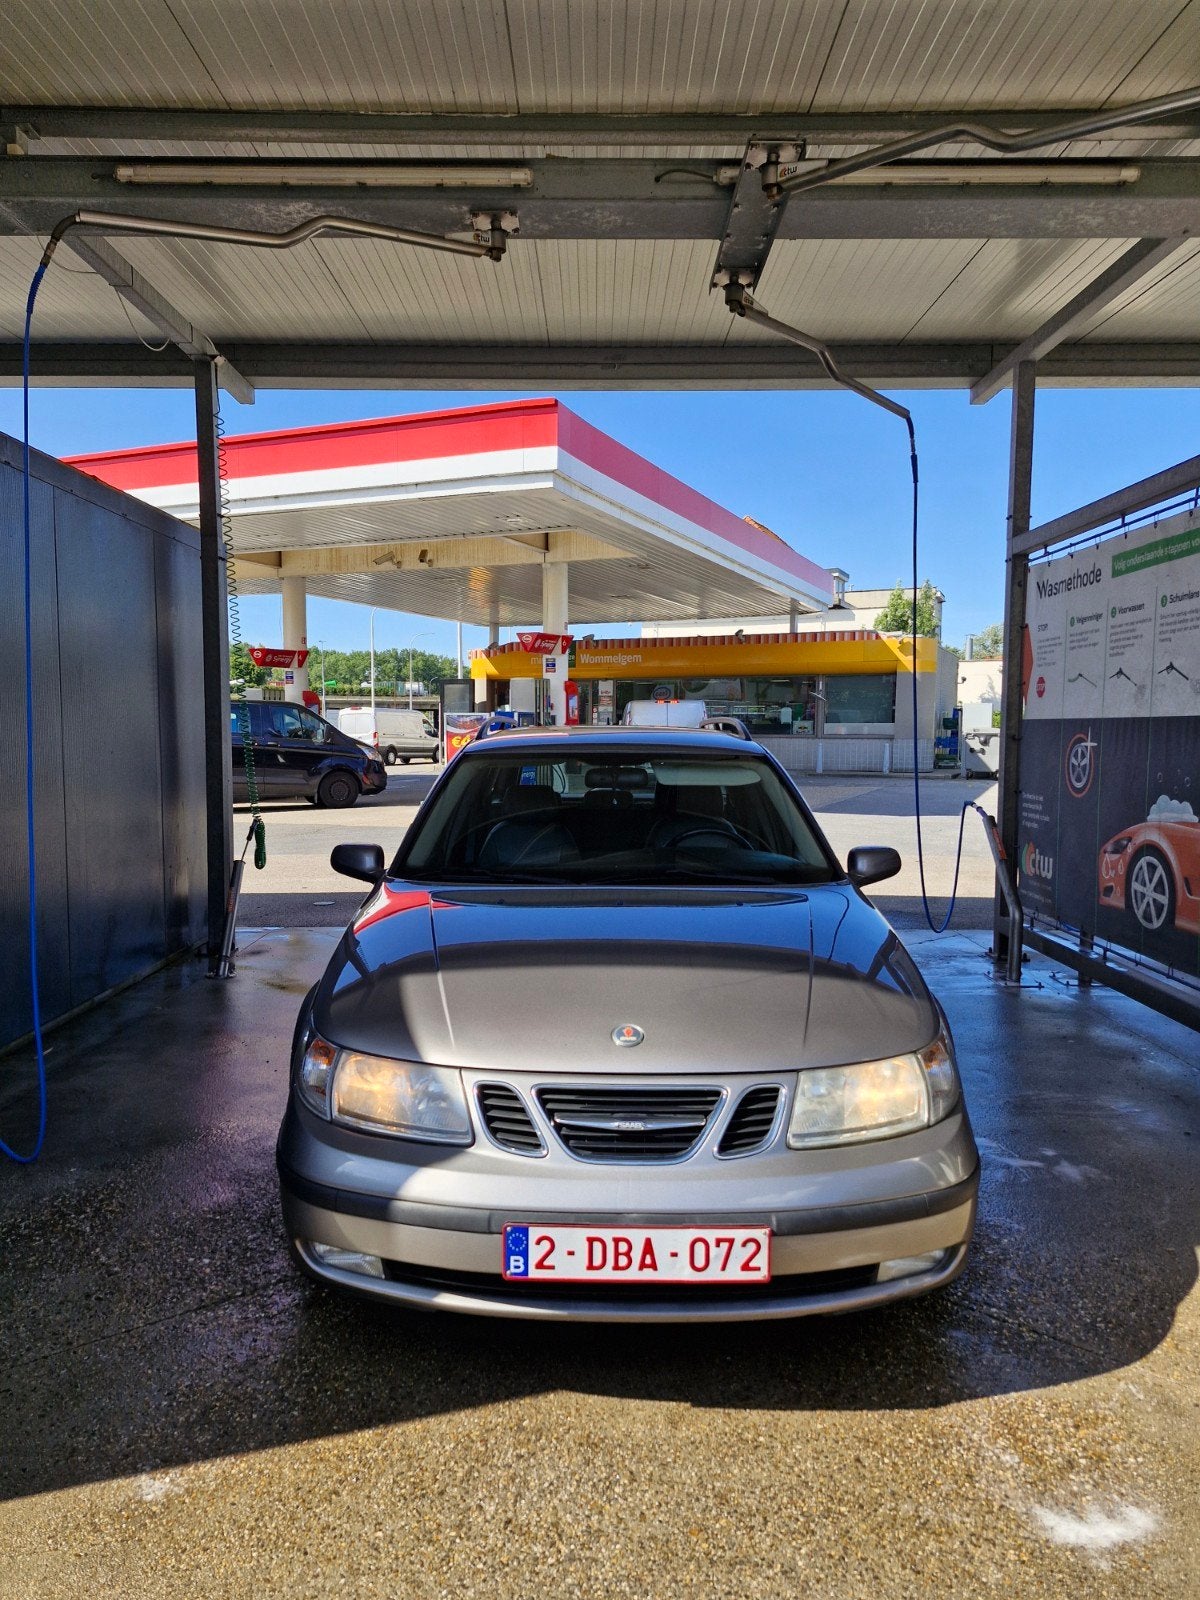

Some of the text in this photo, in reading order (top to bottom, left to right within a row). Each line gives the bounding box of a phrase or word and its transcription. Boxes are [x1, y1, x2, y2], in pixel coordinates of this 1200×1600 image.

[1036, 562, 1102, 599] Wasmethode
[1118, 603, 1145, 614] Voorwassen
[580, 653, 642, 666] Wommelgem
[1030, 848, 1053, 880] ctw
[510, 1256, 525, 1273] B
[534, 1235, 762, 1273] 2-DBA-072
